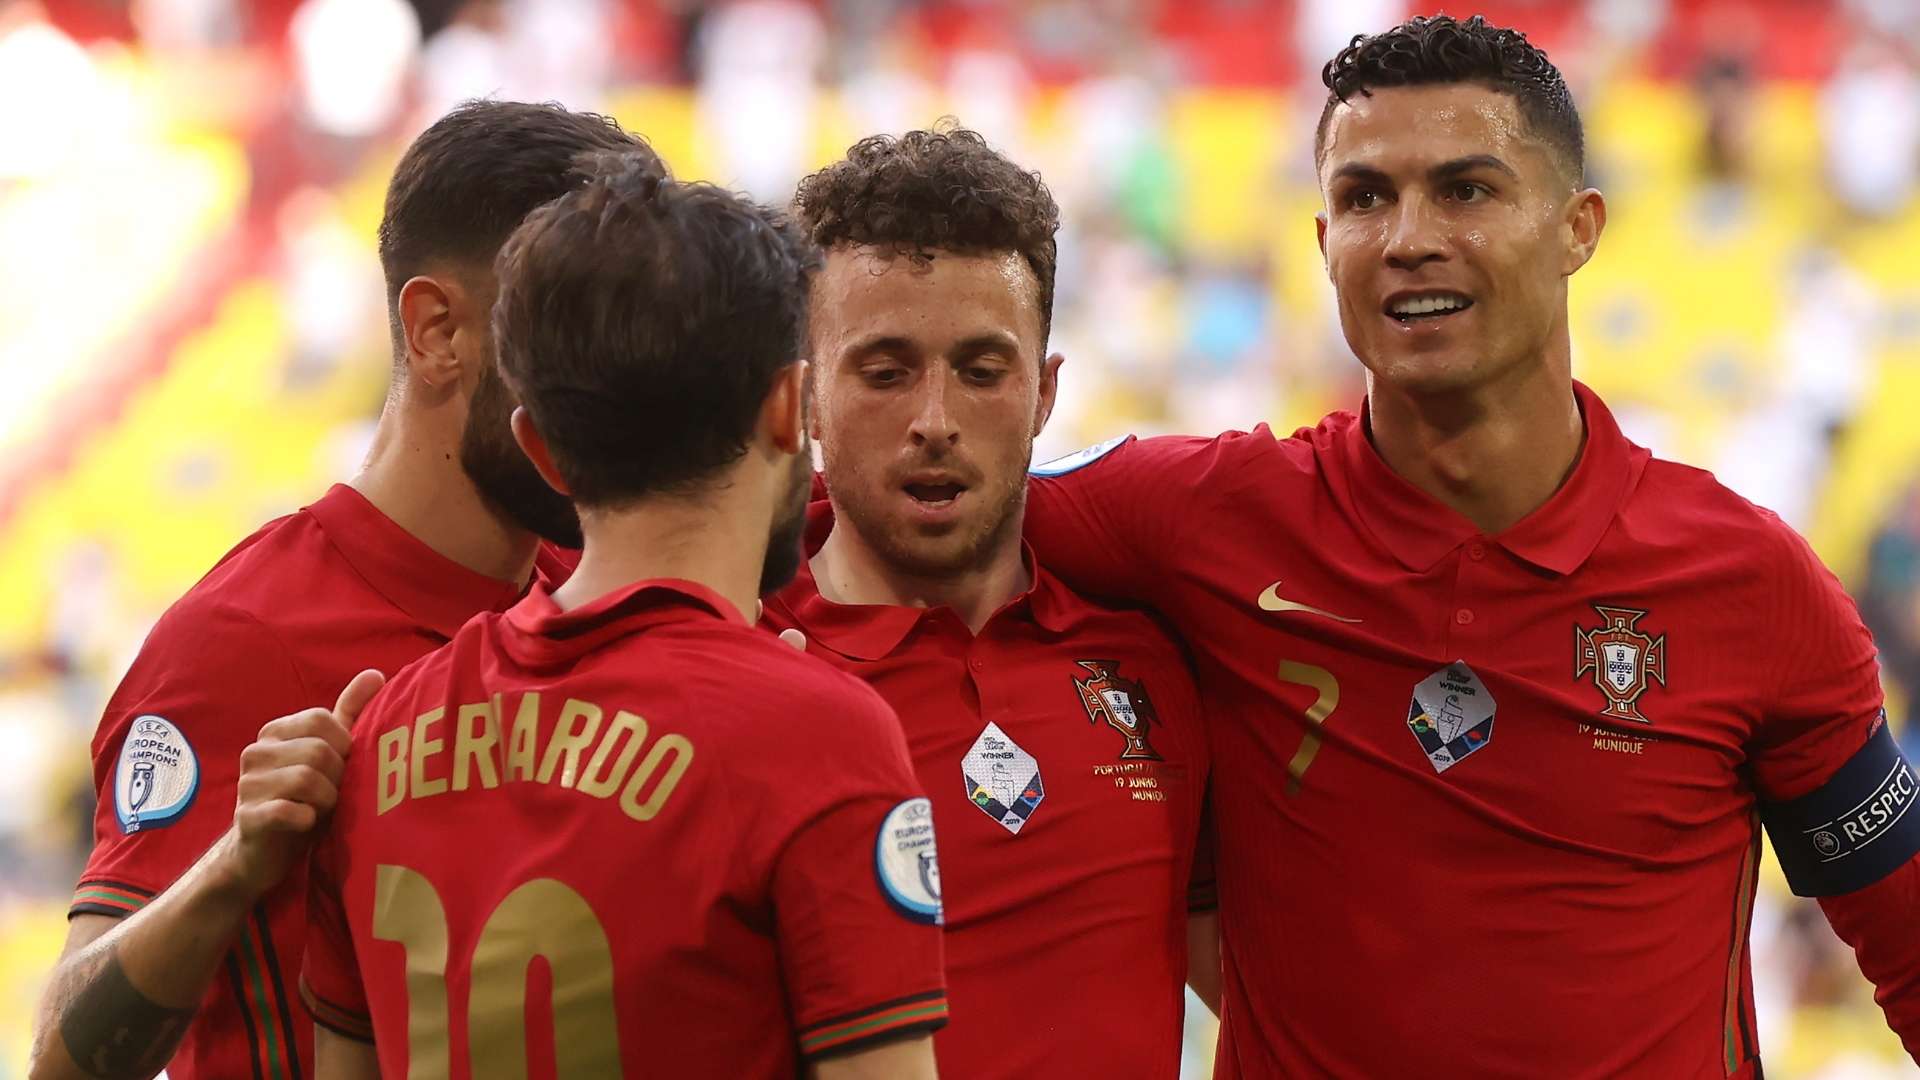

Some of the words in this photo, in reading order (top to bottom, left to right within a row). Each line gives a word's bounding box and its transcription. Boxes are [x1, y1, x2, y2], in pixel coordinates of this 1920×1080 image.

[136, 722, 169, 738] UEFA
[1278, 659, 1340, 795] 7
[128, 739, 181, 757] ROPEAN
[1593, 738, 1643, 754] MUNIQUE
[130, 751, 178, 767] AMPIONS
[377, 692, 694, 821] BERARDO
[1114, 777, 1124, 788] 19
[1129, 777, 1158, 788] JUNHO
[1843, 765, 1915, 842] RESPECT
[372, 864, 624, 1080] 10
